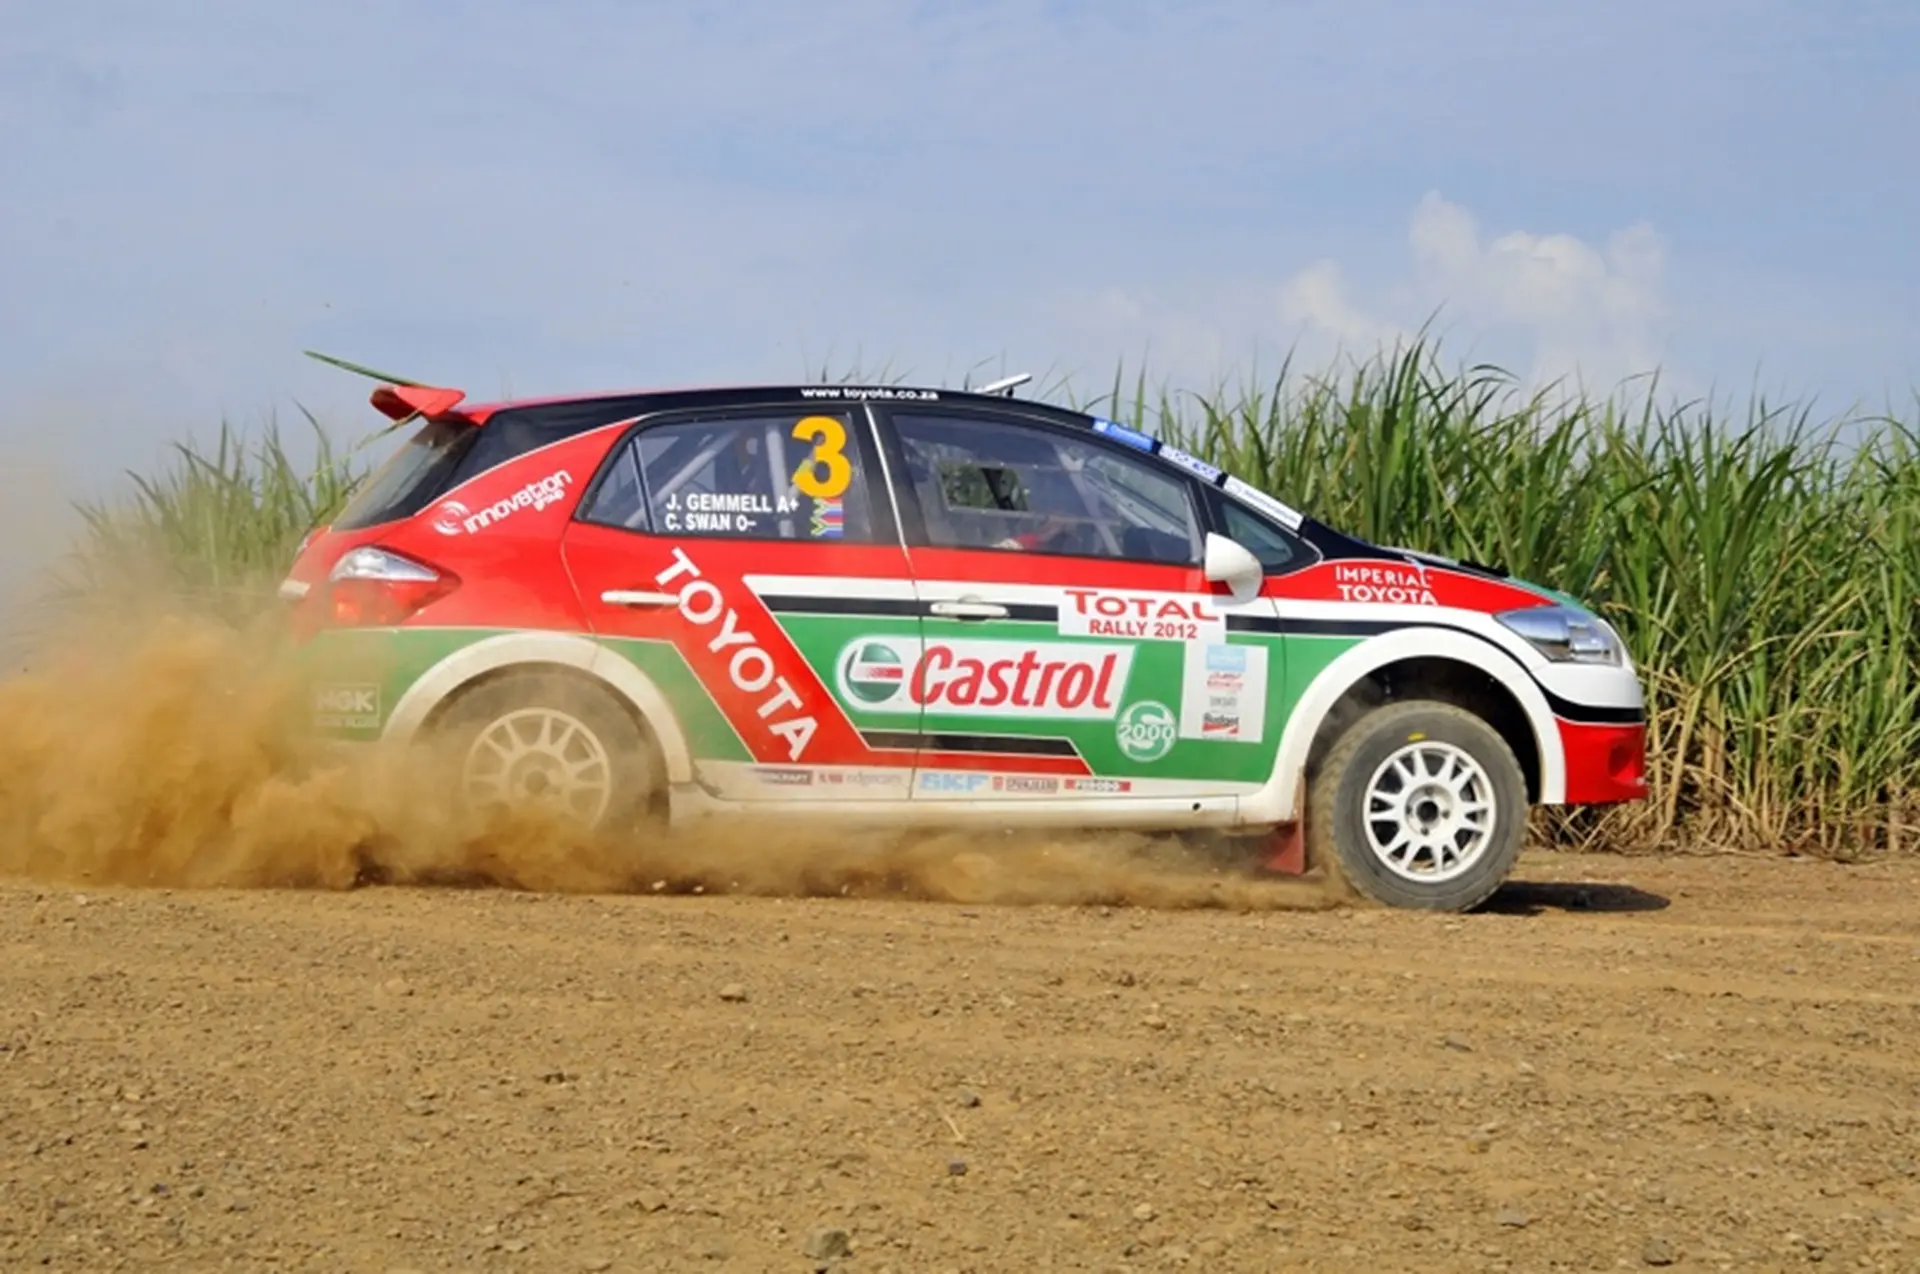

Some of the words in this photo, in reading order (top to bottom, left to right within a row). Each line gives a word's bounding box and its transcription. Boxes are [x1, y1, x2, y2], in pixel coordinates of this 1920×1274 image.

[791, 415, 851, 498] 3
[463, 469, 573, 534] innovation
[666, 494, 682, 511] J.
[686, 493, 772, 513] GEMMELL
[776, 495, 800, 513] A+
[665, 513, 681, 530] C.
[685, 513, 731, 530] SWAN
[1335, 565, 1432, 588] IMPERIAL
[1064, 589, 1219, 622] TOTAL
[1337, 584, 1439, 606] TOYOTA
[1089, 619, 1148, 637] RALLY
[1154, 622, 1197, 639] 2012
[654, 547, 818, 762] TOYOTA
[909, 645, 1117, 709] Castrol
[1118, 722, 1176, 742] 2000
[920, 772, 989, 791] SKF
